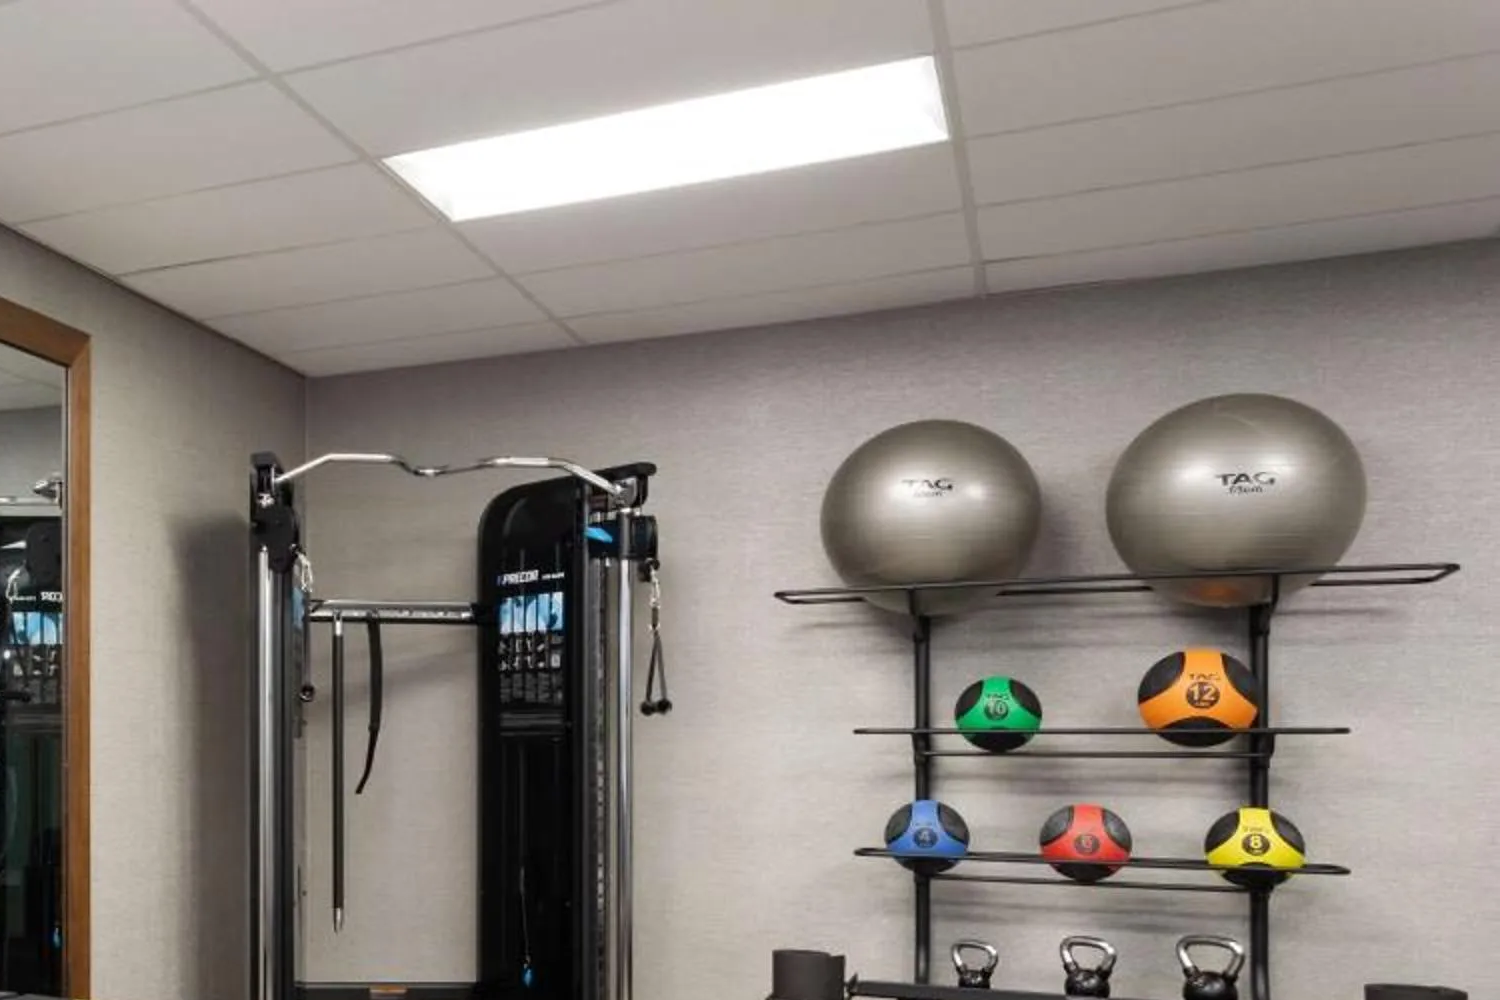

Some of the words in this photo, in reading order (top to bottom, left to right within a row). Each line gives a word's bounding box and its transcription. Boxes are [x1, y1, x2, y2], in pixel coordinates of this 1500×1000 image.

[1214, 471, 1279, 486] TAG
[1190, 683, 1217, 701] 12
[1250, 834, 1262, 849] 8
